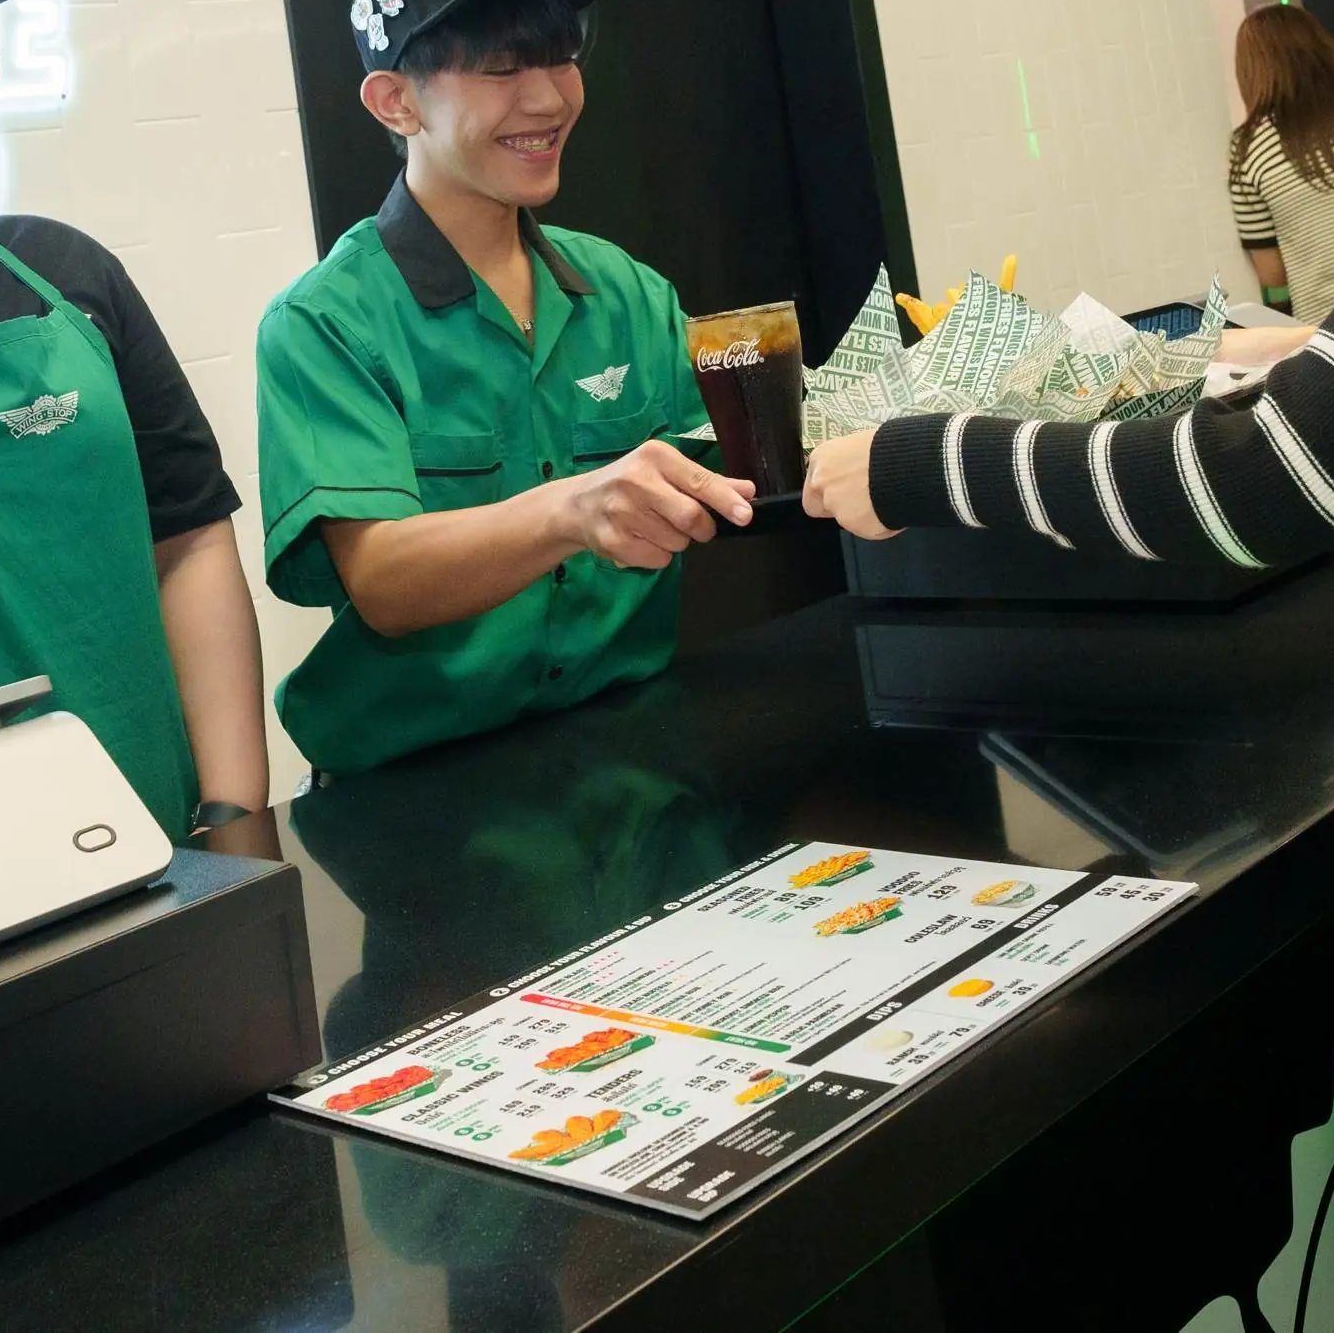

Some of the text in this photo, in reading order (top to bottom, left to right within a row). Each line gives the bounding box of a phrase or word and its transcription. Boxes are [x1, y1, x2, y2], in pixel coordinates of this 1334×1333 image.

[946, 276, 984, 387] FRIES FLAVOUR
[996, 297, 1011, 336] FRIES
[697, 338, 761, 373] Coca-Cola
[969, 327, 993, 364] WINGS
[878, 871, 920, 892] VOODOO
[927, 885, 957, 900] 129
[794, 896, 824, 911] 109
[1013, 903, 1060, 929] DRINKS
[904, 914, 958, 944] COLESLAW
[970, 918, 996, 930] 69
[579, 927, 628, 953] FLAVOUR
[867, 1000, 904, 1022] DIPS
[328, 1010, 464, 1076] CHOOSE YOUR MEAL
[407, 1025, 471, 1055] BONELESS
[401, 1070, 505, 1123] CLASSIC WINGS
[585, 1069, 643, 1099] TENDERS
